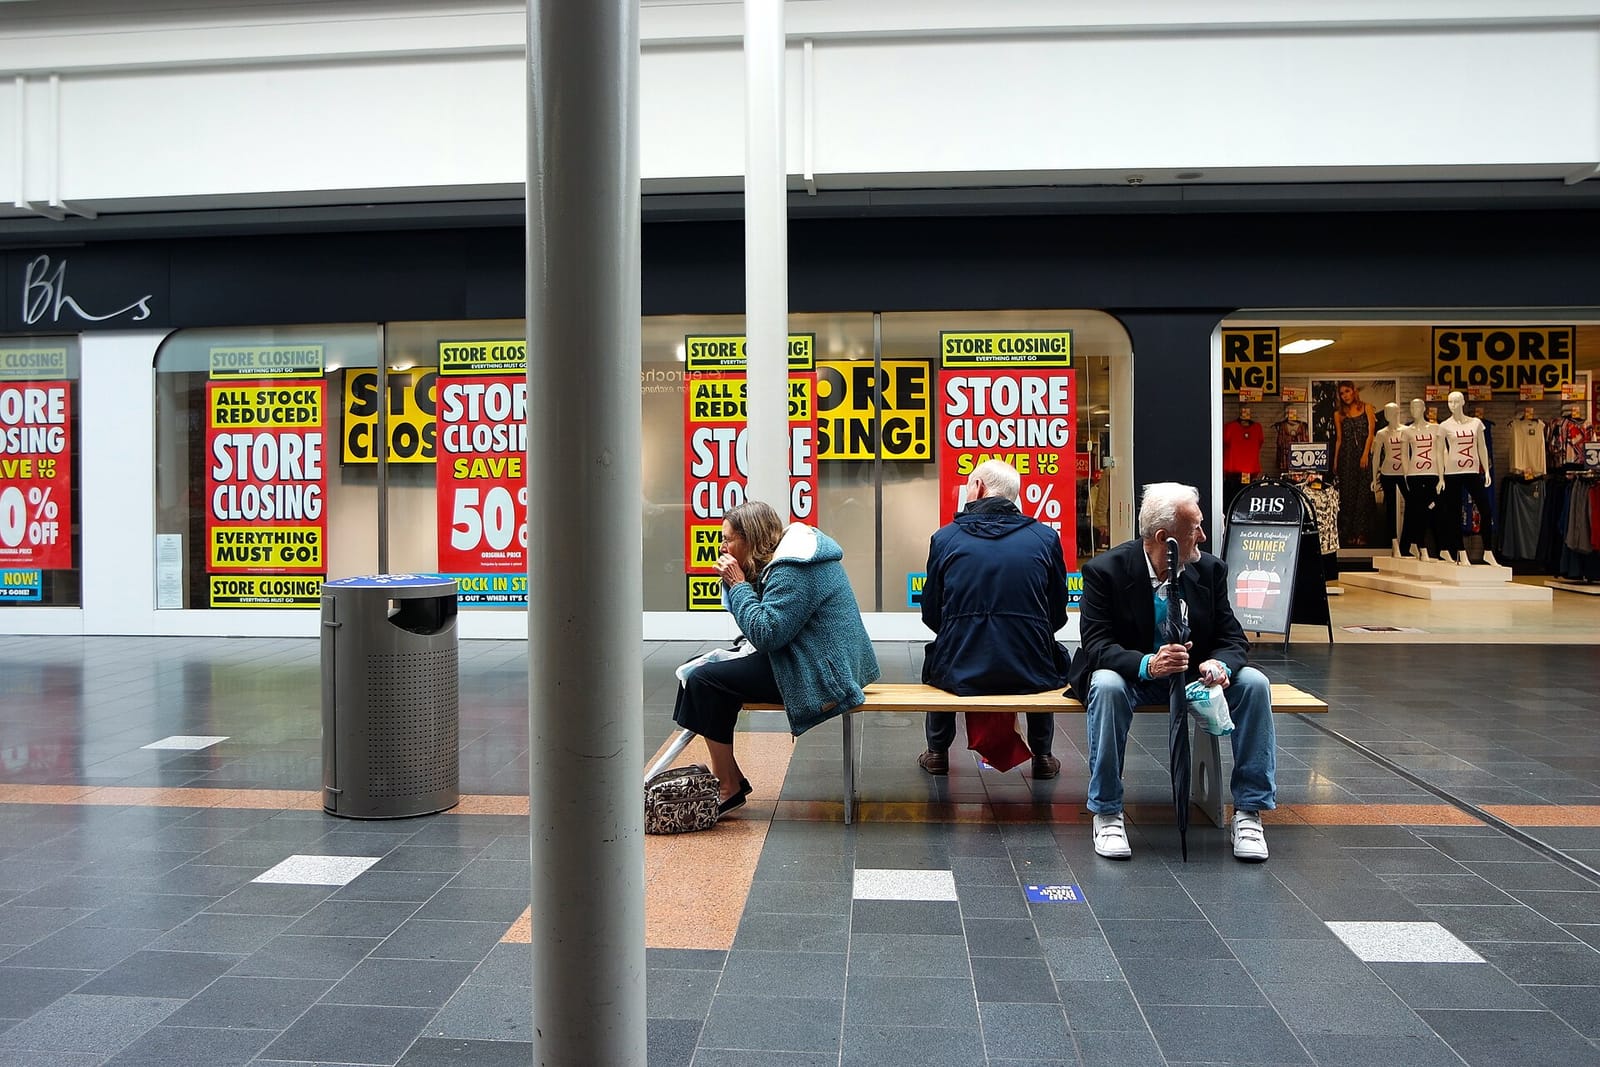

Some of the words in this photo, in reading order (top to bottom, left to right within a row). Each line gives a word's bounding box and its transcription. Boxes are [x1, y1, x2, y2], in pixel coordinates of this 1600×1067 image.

[691, 342, 737, 357] STORE
[946, 338, 993, 353] STORE
[998, 337, 1066, 353] CLOSING!
[1438, 331, 1569, 361] STORE
[5, 352, 64, 368] CLOSING!
[212, 351, 254, 367] STORE
[258, 350, 319, 366] CLOSING!
[443, 346, 486, 362] STORE
[1437, 363, 1569, 389] CLOSING!
[217, 392, 250, 405] ALL
[256, 391, 317, 405] STOCK
[695, 384, 733, 398] ALL
[945, 376, 1069, 416] STORE
[216, 407, 318, 423] REDUCED!
[945, 418, 1069, 449] CLOSING
[212, 432, 322, 481] STORE
[1416, 433, 1433, 470] SALE
[1456, 429, 1474, 468] SALE
[38, 459, 56, 468] UP
[1038, 453, 1059, 463] UP
[1291, 450, 1327, 467] 30%
[39, 469, 56, 478] TO
[453, 457, 521, 479] SAVE
[1038, 464, 1059, 474] TO
[212, 484, 322, 520] CLOSING
[1249, 497, 1285, 513] BHS
[29, 521, 59, 545] OFF
[216, 532, 318, 544] EVERYTHING
[1242, 539, 1286, 552] SUMMER
[216, 547, 272, 562] MUST
[280, 547, 318, 562] GO!
[1249, 551, 1261, 561] ON
[1262, 552, 1277, 562] ICE
[4, 571, 38, 585] NOW!
[493, 577, 508, 591] IN
[213, 581, 254, 595] STORE
[259, 581, 320, 595] CLOSING!
